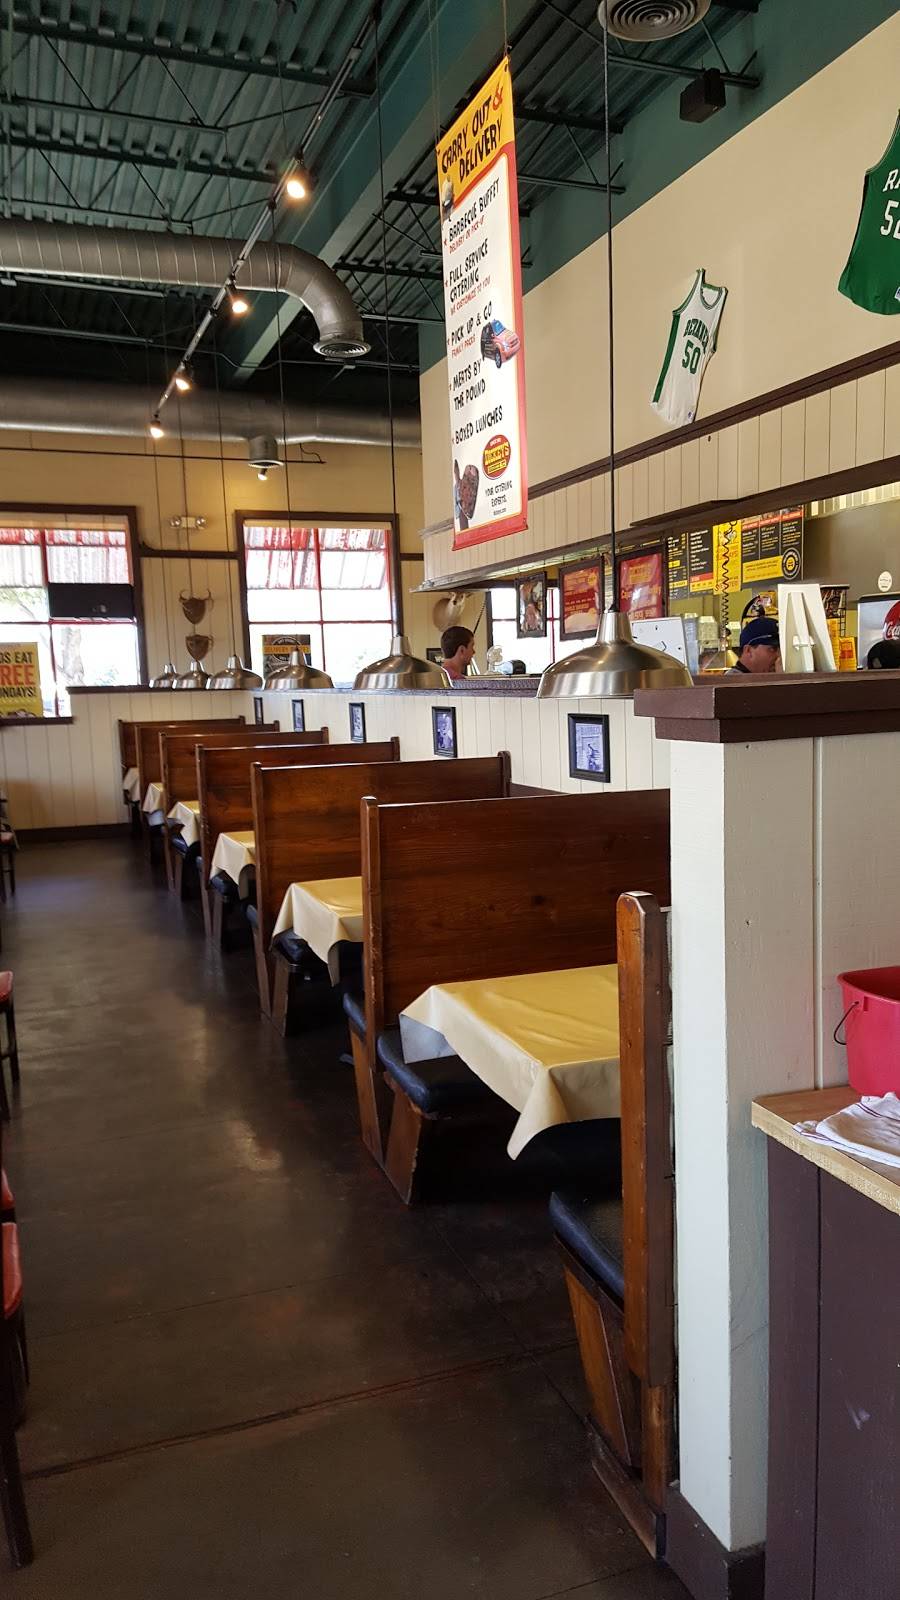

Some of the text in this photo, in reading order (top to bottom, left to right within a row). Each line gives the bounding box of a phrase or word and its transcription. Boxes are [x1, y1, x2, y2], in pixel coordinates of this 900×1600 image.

[442, 83, 503, 173] CARRY OUT &
[460, 114, 502, 182] DELIVERY
[449, 178, 499, 242] BARBECUE BUFFET
[449, 238, 488, 287] FULL SERVICE
[450, 267, 479, 302] CATERING
[451, 300, 492, 346] PICK UP & GO
[453, 358, 481, 391] MEATS BY
[682, 340, 701, 374] 50
[453, 378, 485, 411] THE POUND
[455, 405, 503, 444] BOXED LUNCHES
[15, 652, 33, 663] EAT
